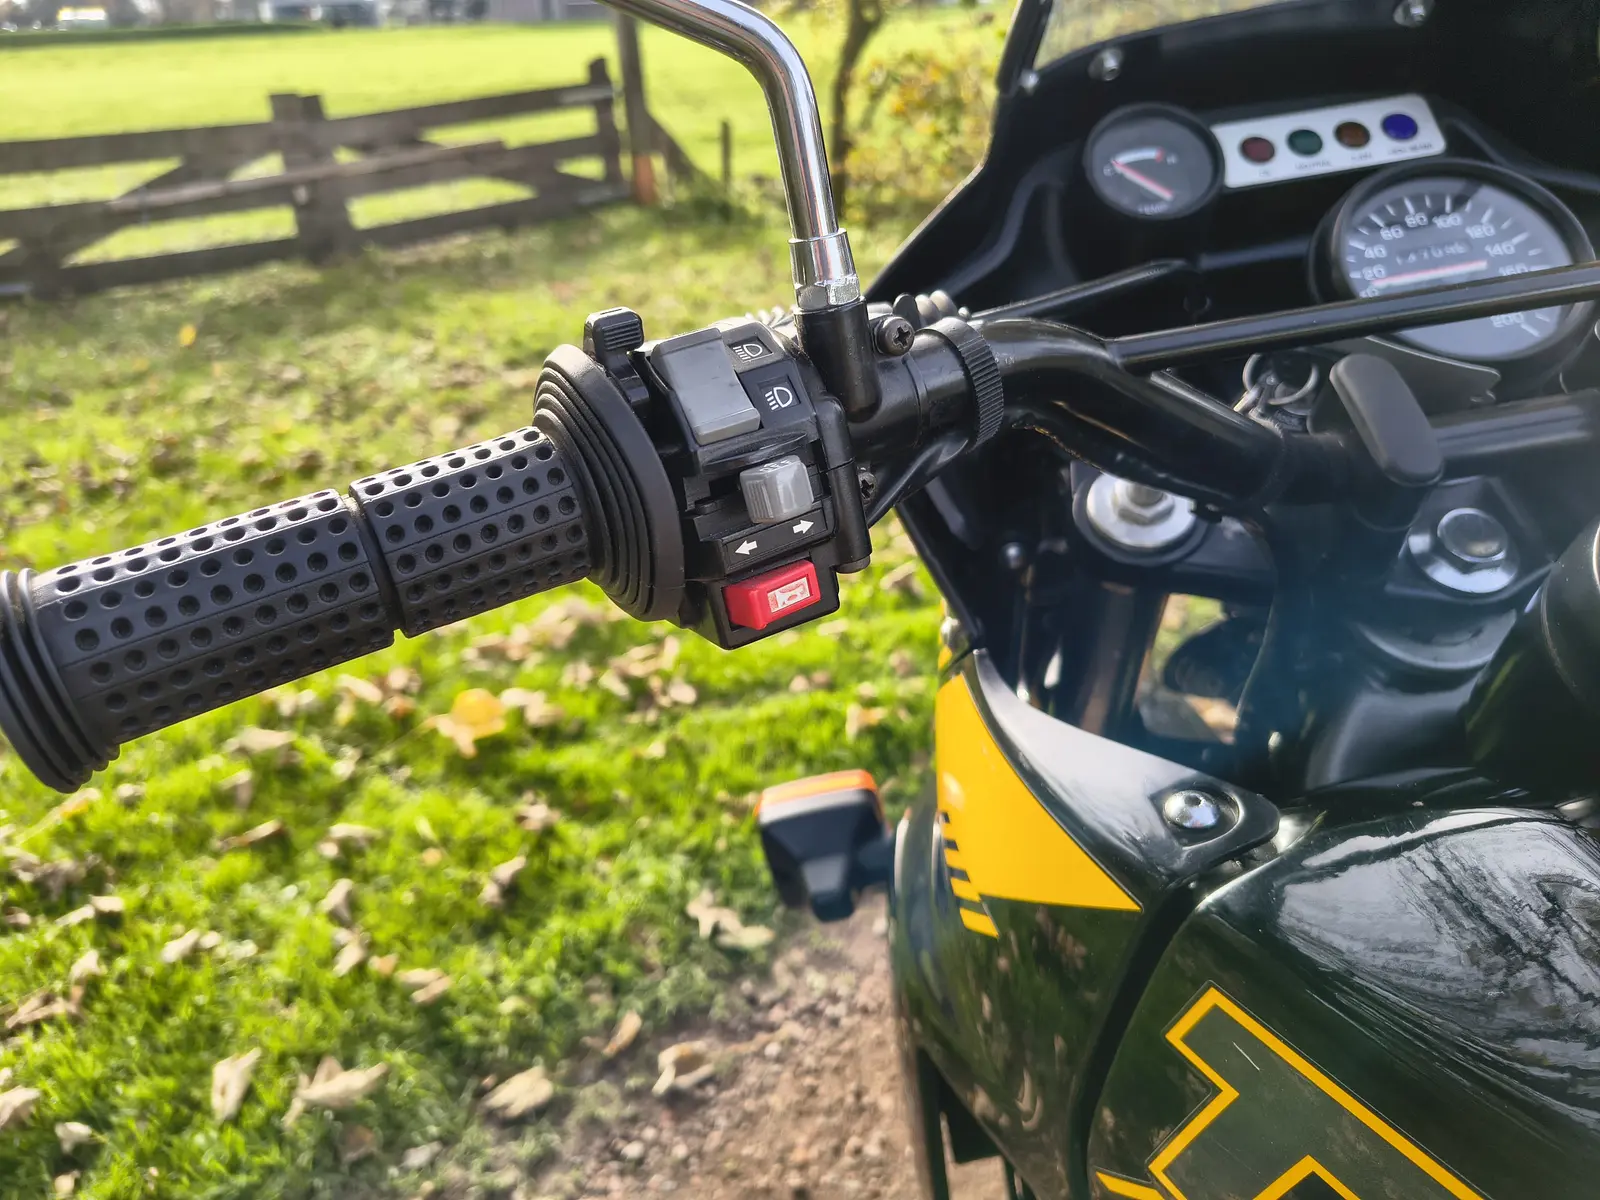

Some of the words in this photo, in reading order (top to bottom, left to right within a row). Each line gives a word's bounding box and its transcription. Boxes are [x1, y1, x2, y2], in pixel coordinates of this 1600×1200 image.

[1405, 212, 1428, 227] 80
[1432, 212, 1463, 229] 100
[1380, 225, 1404, 240] 60
[1465, 223, 1495, 239] 120
[1365, 244, 1387, 259] 40
[1485, 241, 1516, 257] 140
[1362, 264, 1386, 280] 20
